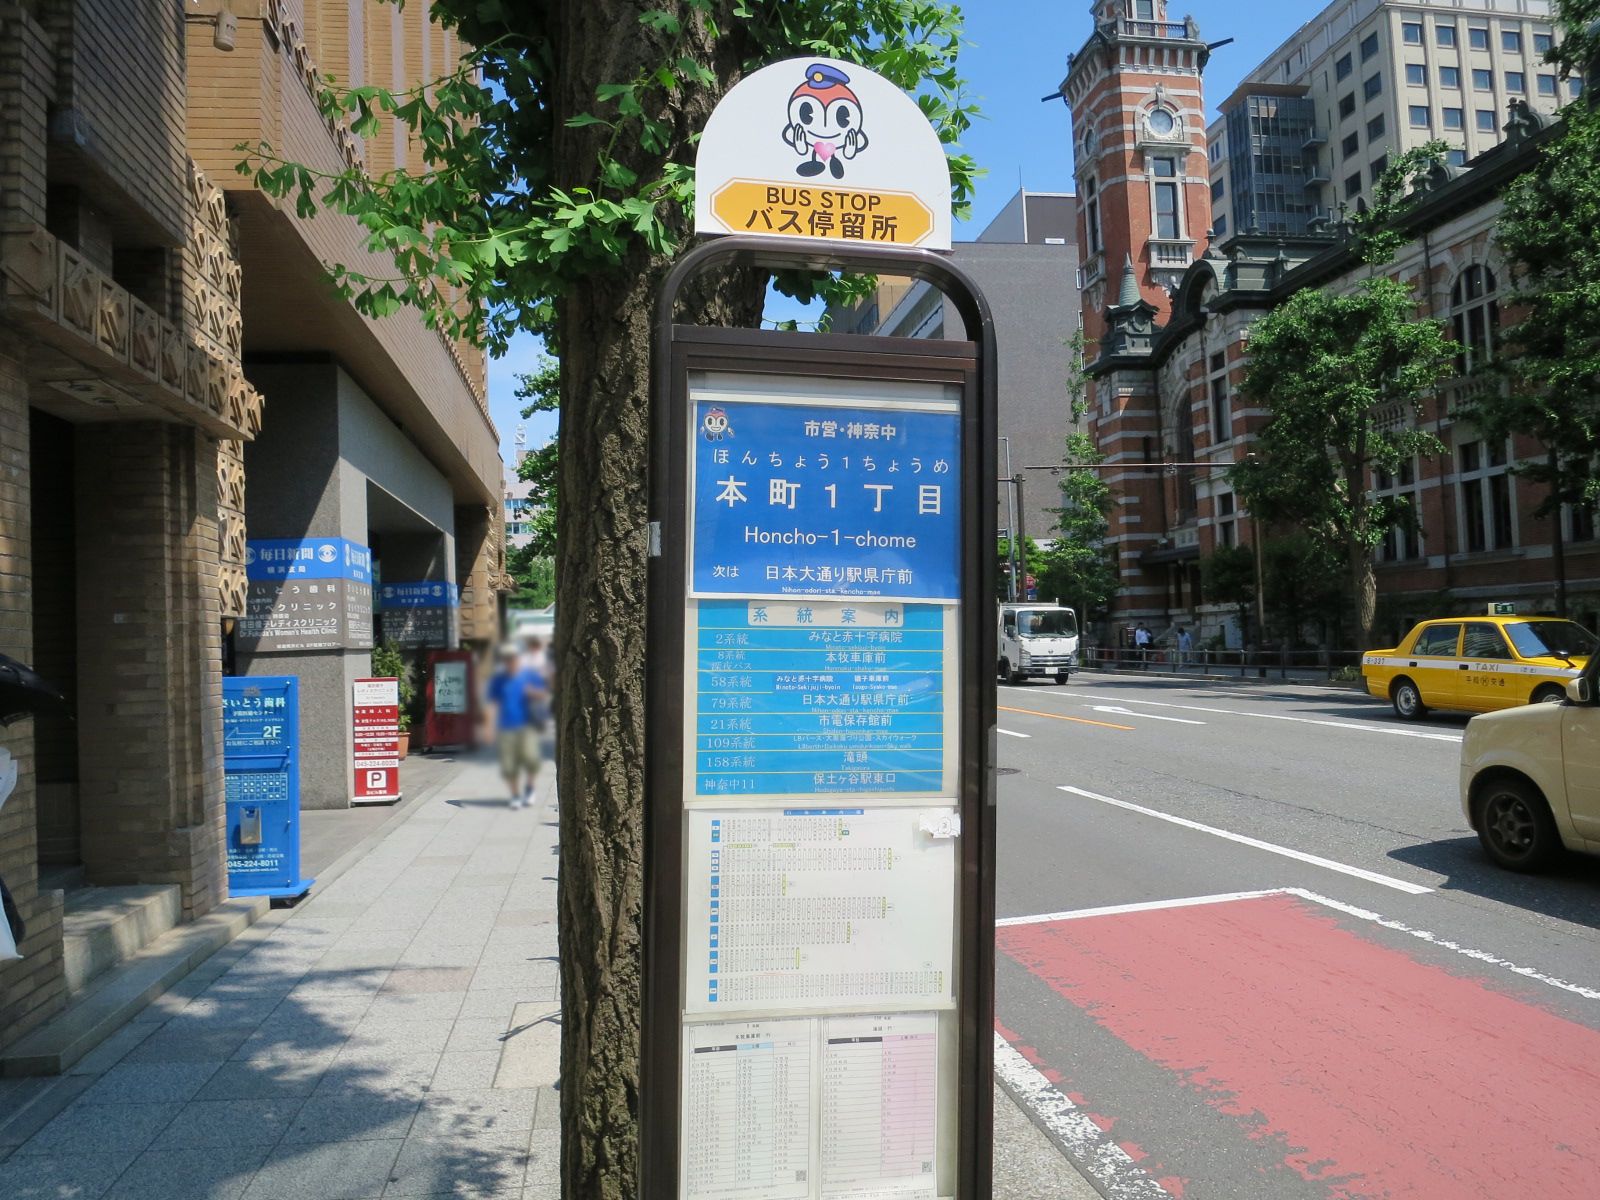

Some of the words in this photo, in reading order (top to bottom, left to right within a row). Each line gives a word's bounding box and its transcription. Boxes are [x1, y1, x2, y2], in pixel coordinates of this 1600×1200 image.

[766, 187, 811, 207] BUS
[820, 192, 881, 212] STOP
[745, 206, 898, 242] バス停留所
[804, 420, 897, 441] 市営・神奈中
[715, 475, 942, 515] 本町1丁目
[745, 526, 917, 548] Honcho-1-chome
[260, 547, 314, 562] 毎日新聞
[712, 564, 740, 578] 次は
[766, 565, 913, 585] 日本大通り駅県庁前
[752, 607, 900, 624] 系統案内
[321, 627, 337, 635] Clinic
[715, 632, 750, 646] 2系統
[808, 630, 903, 644] みなと赤十字病院
[825, 651, 887, 664] 本牧車庫前
[1474, 663, 1499, 671] TAXI
[711, 676, 752, 688] 58系統
[711, 696, 752, 709] 79系統
[802, 693, 910, 707] 日本大通り駅県庁前
[710, 718, 752, 730] 21系統
[818, 714, 893, 727] 市電保存館前
[263, 725, 282, 738] 2F
[706, 737, 756, 750] 109系統
[706, 756, 756, 768] 158系統
[371, 771, 382, 787] P
[704, 778, 756, 791] 神奈中11
[813, 773, 896, 786] 保土ヶ谷駅東口
